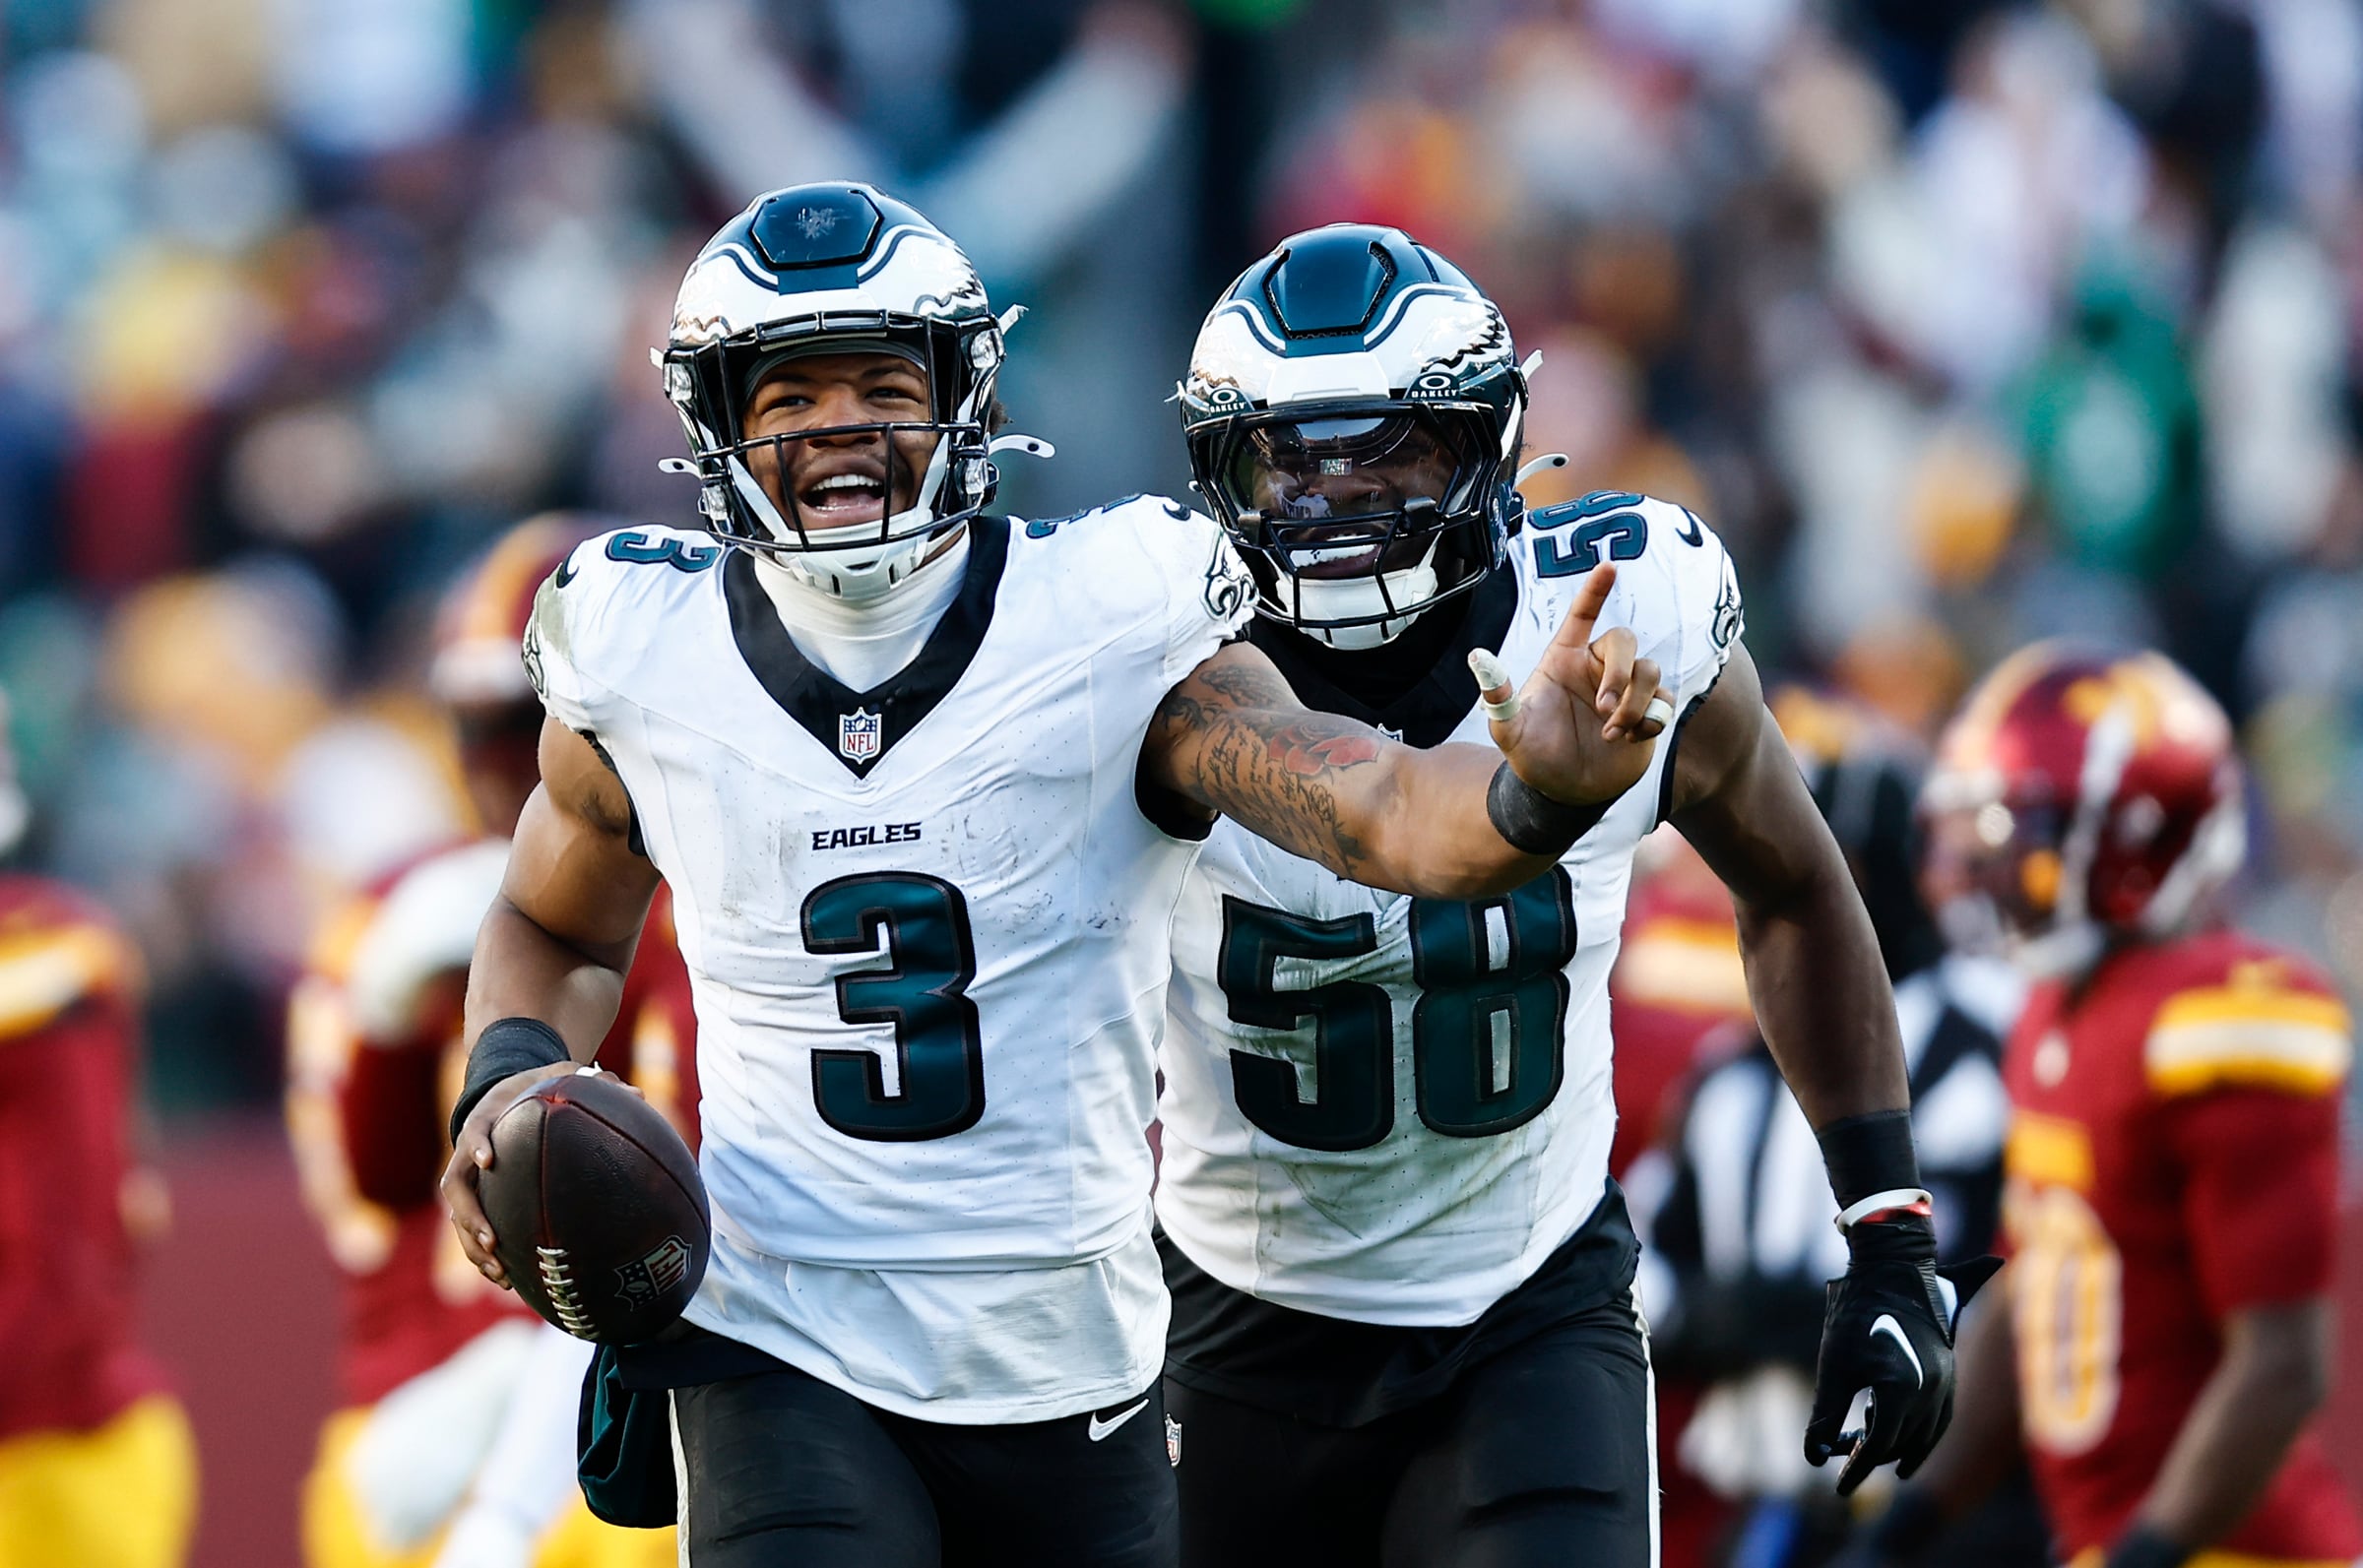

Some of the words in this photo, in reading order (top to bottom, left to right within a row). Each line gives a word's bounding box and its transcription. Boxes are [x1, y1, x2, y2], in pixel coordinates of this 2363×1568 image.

[1209, 401, 1246, 413] OAKLEY
[1411, 389, 1457, 399] OAKLEY
[605, 532, 723, 573] 3
[1527, 490, 1648, 579] 58
[847, 733, 873, 753] NFL
[811, 821, 923, 851] EAGLES
[800, 870, 986, 1143] 3
[1217, 863, 1577, 1152] 58
[648, 1241, 685, 1294] NFL
